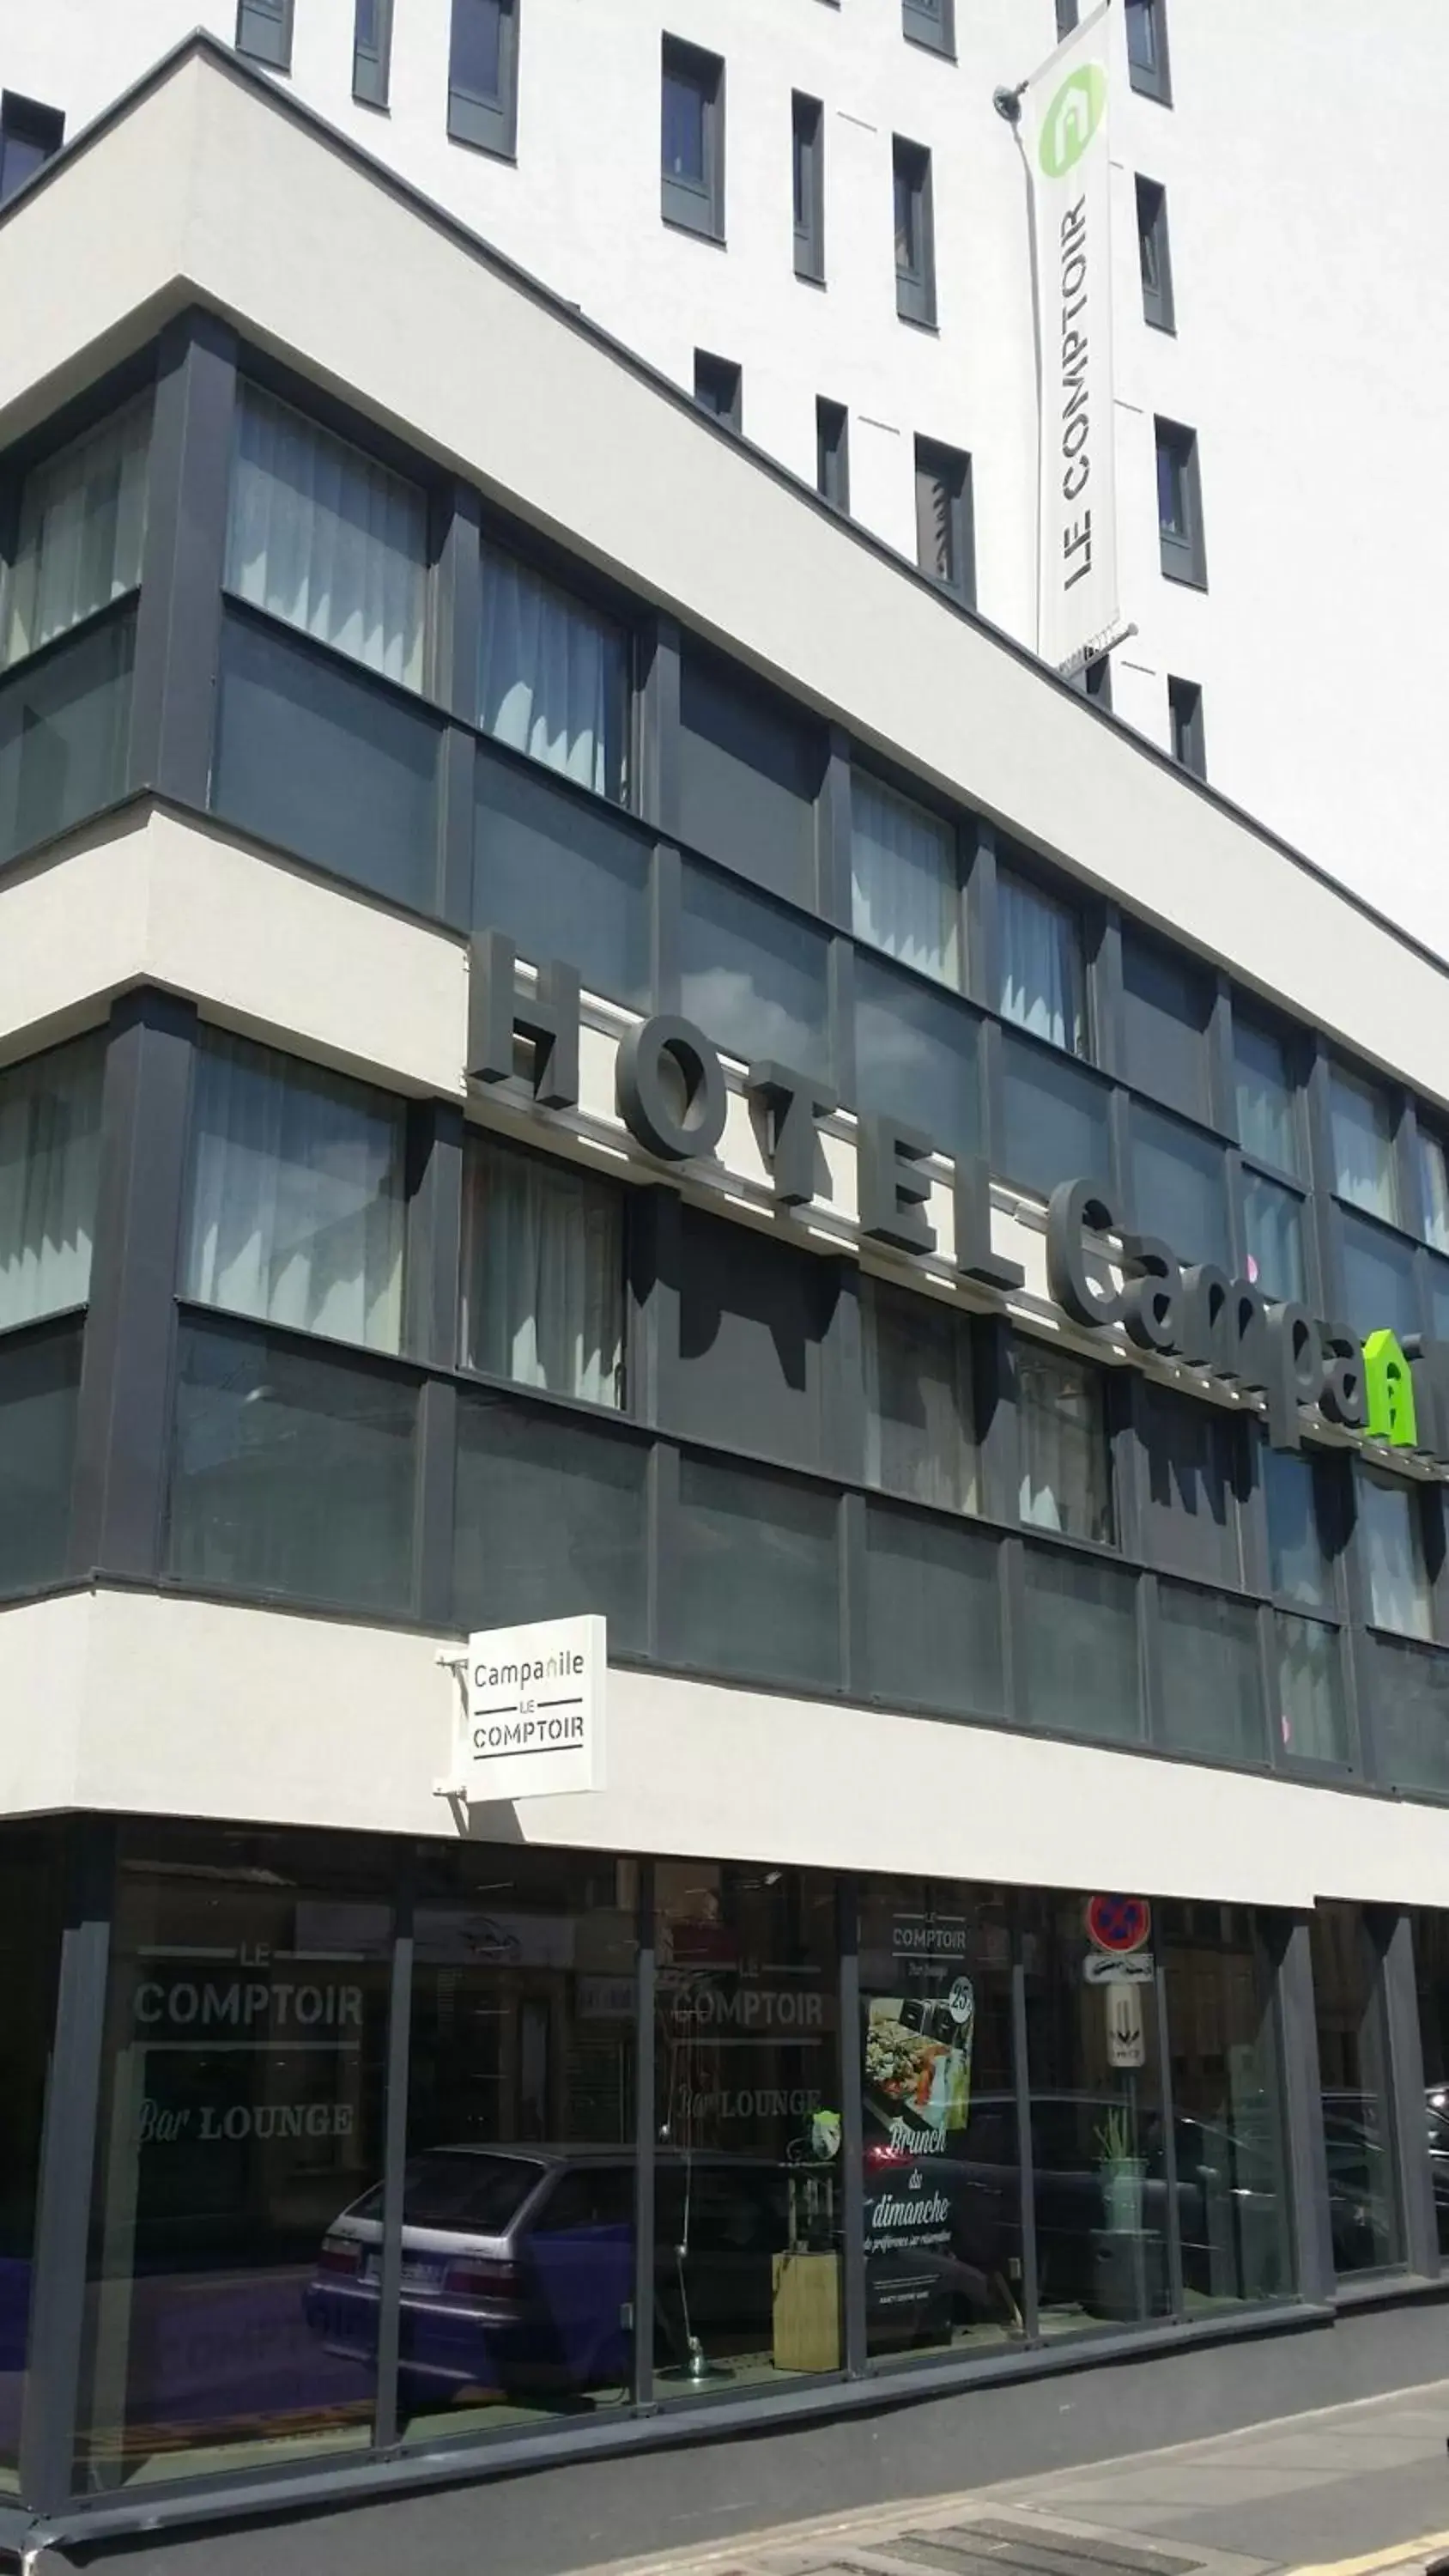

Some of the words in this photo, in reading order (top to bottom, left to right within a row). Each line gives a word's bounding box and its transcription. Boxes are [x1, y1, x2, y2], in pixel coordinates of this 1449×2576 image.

[1060, 193, 1090, 500] COMPTOIR
[1064, 509, 1092, 592] LE
[468, 930, 1025, 1291] HOTEL
[475, 1649, 584, 1690] Campanile
[520, 1700, 535, 1714] LE
[474, 1716, 584, 1748] COMPTOIR
[239, 1941, 270, 1967] LE
[893, 1929, 967, 1949] COMPTOIR
[739, 1958, 759, 1978] LE
[134, 1982, 363, 2025] COMPTOIR
[673, 1991, 822, 2025] COMPTOIR
[139, 2098, 190, 2142] Bar
[198, 2104, 353, 2139] LOUNGE
[721, 2090, 822, 2117] LOUNGE
[888, 2117, 947, 2154] Brunch
[872, 2191, 951, 2228] dimanche
